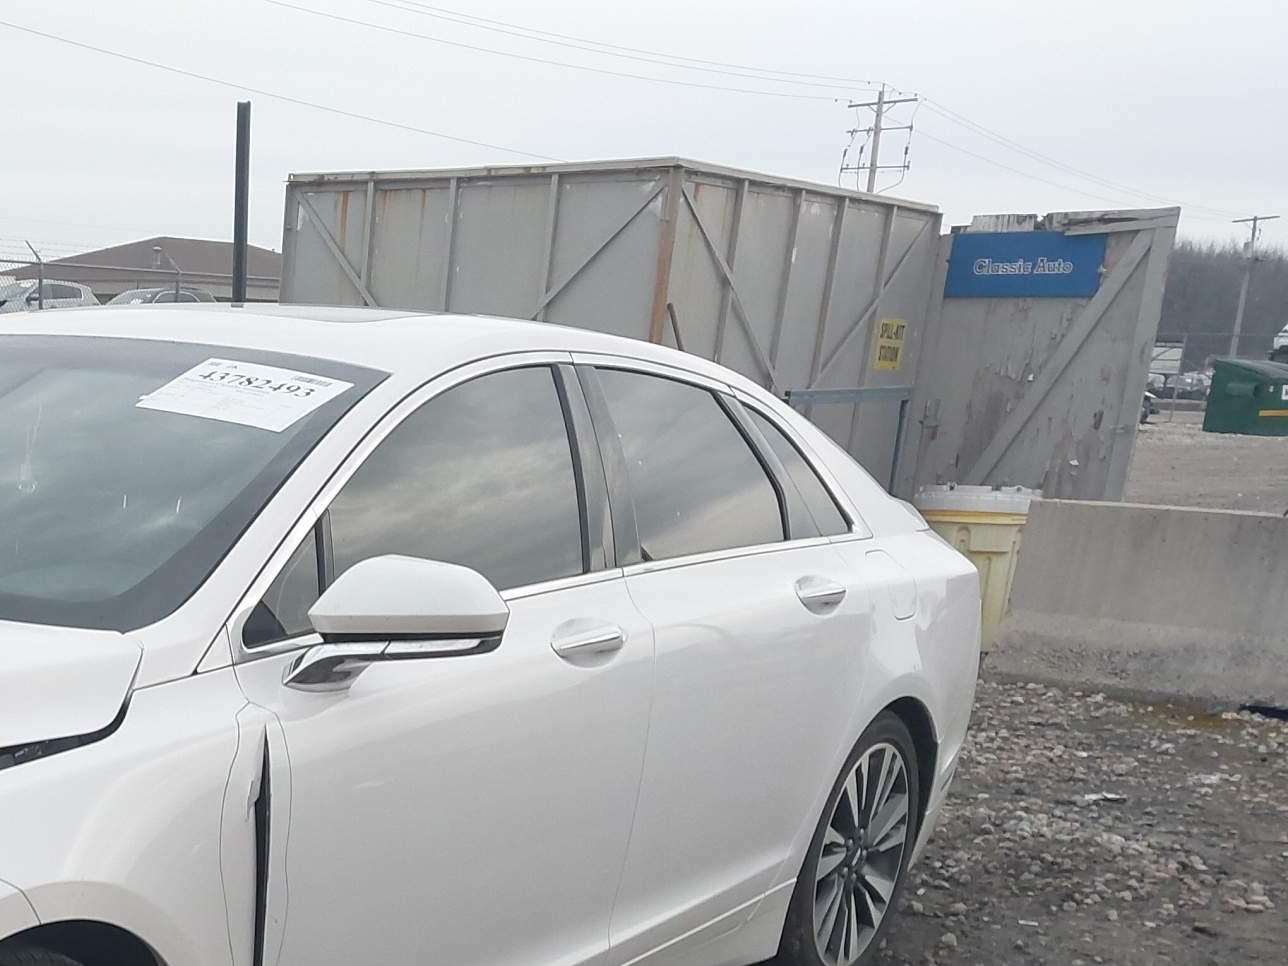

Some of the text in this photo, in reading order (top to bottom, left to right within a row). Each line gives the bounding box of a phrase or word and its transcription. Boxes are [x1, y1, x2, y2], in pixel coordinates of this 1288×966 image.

[973, 257, 1073, 275] Classic Auto
[199, 370, 316, 397] 43782493
